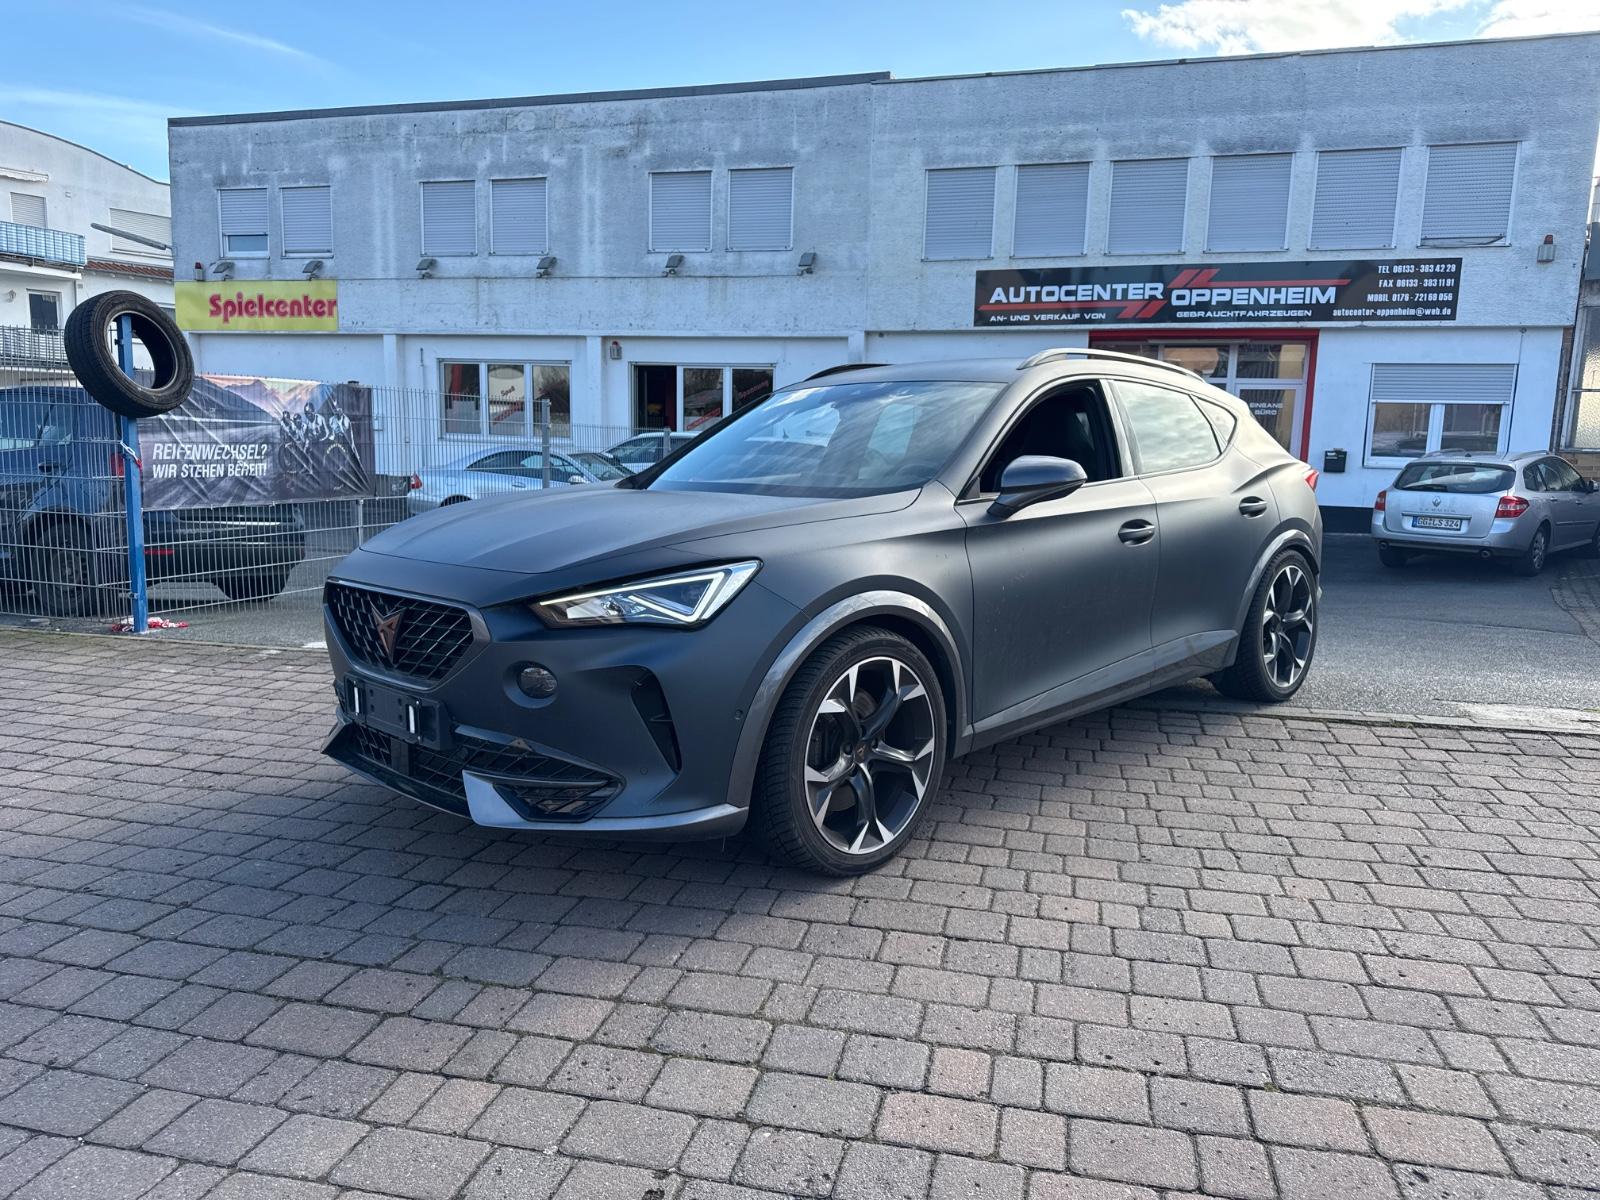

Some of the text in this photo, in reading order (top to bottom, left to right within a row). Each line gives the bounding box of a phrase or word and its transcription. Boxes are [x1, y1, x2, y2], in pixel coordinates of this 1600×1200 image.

[1378, 266, 1390, 274] TEL
[1378, 279, 1394, 288] FAX
[989, 283, 1336, 306] AUTOCENTER OPPENHEIM
[1367, 293, 1389, 302] MOBIL
[209, 291, 337, 324] Spielcenter
[1033, 313, 1080, 321] VERKAUF
[1083, 312, 1106, 320] VON
[1176, 309, 1312, 318] GEBRAUCHTFAHRZEUGEN
[152, 443, 268, 461] REIFENWECHSEL?
[152, 462, 267, 478] WIR STEHEN BEREIT!
